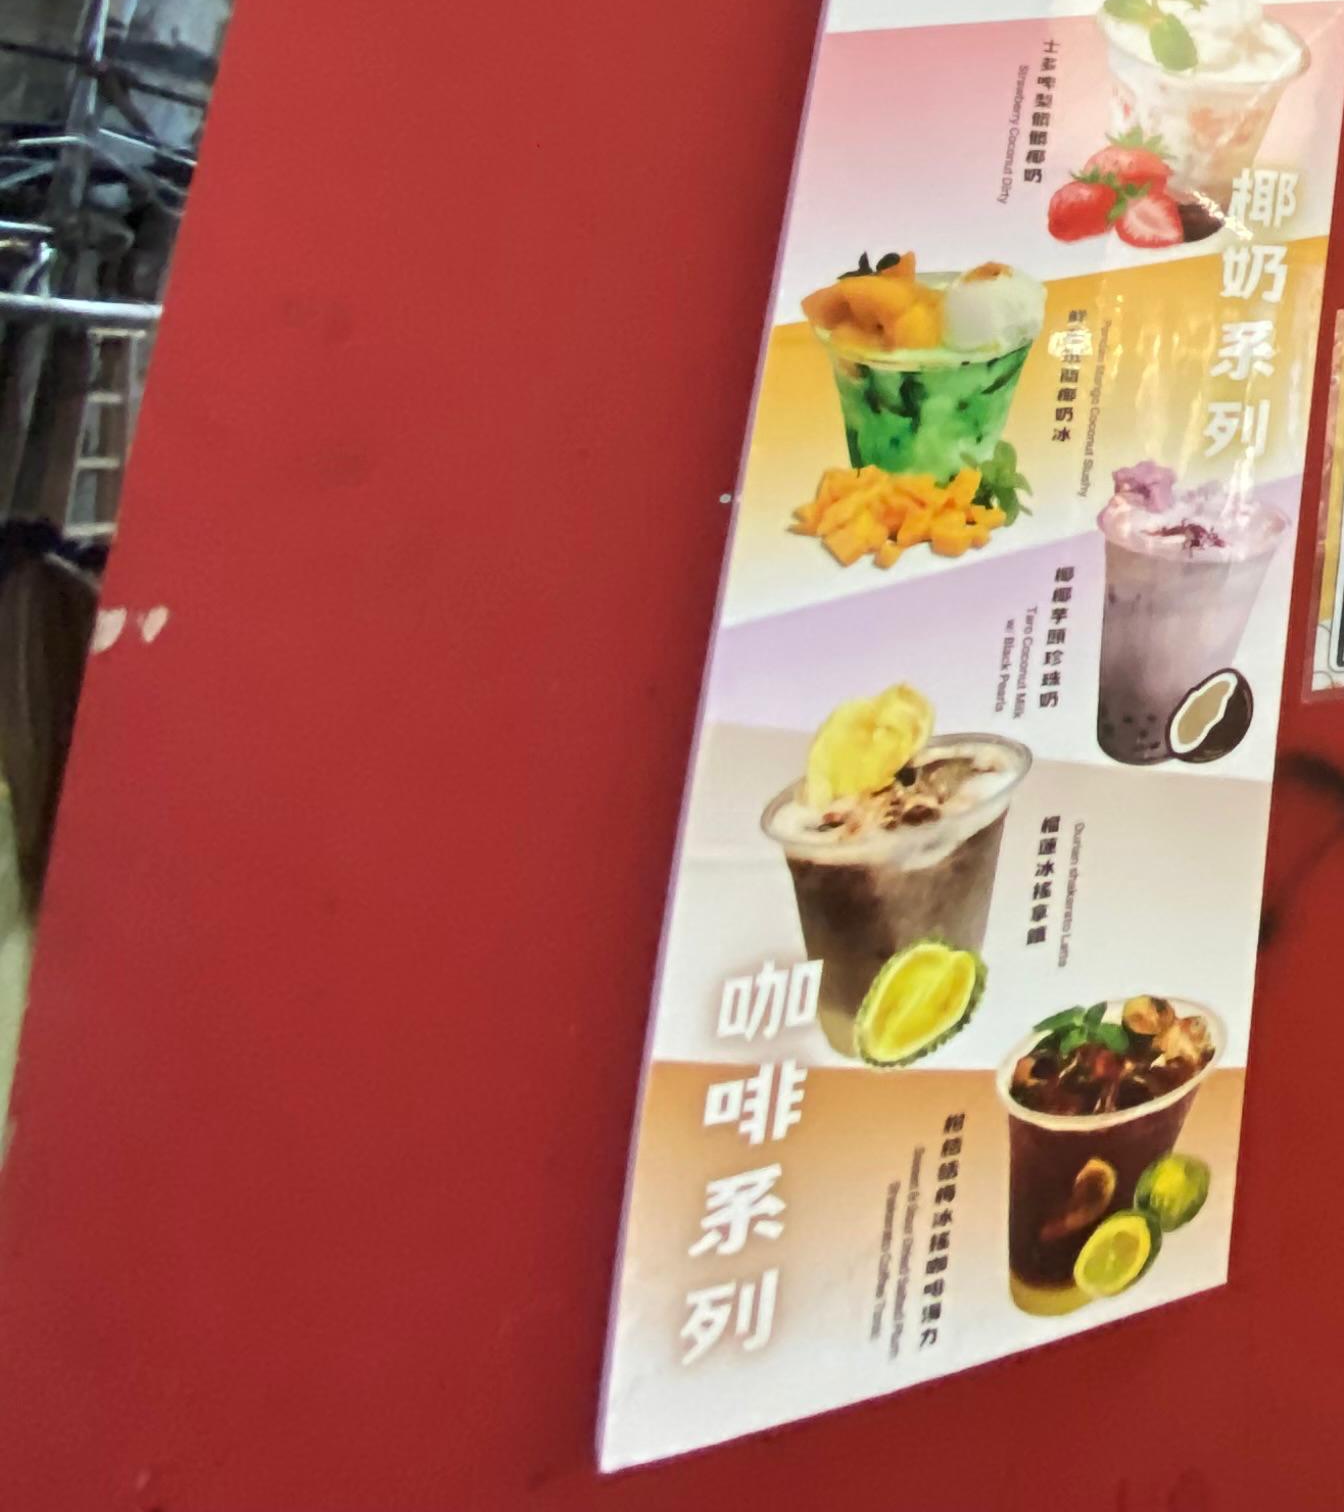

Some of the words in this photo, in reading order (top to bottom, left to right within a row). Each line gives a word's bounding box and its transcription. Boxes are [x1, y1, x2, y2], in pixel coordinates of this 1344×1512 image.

[1003, 126, 1021, 176] Coconut
[997, 176, 1014, 205] Dirty
[1203, 167, 1300, 458] 椰奶系列
[1084, 406, 1100, 456] Coconut
[1024, 605, 1038, 635] Taro
[1000, 636, 1015, 671] Black
[1017, 637, 1033, 689] Coconut
[995, 674, 1010, 713] Pearls
[1013, 692, 1026, 719] Milk
[1070, 822, 1085, 865] Durian
[680, 958, 824, 1367] 咖啡系列
